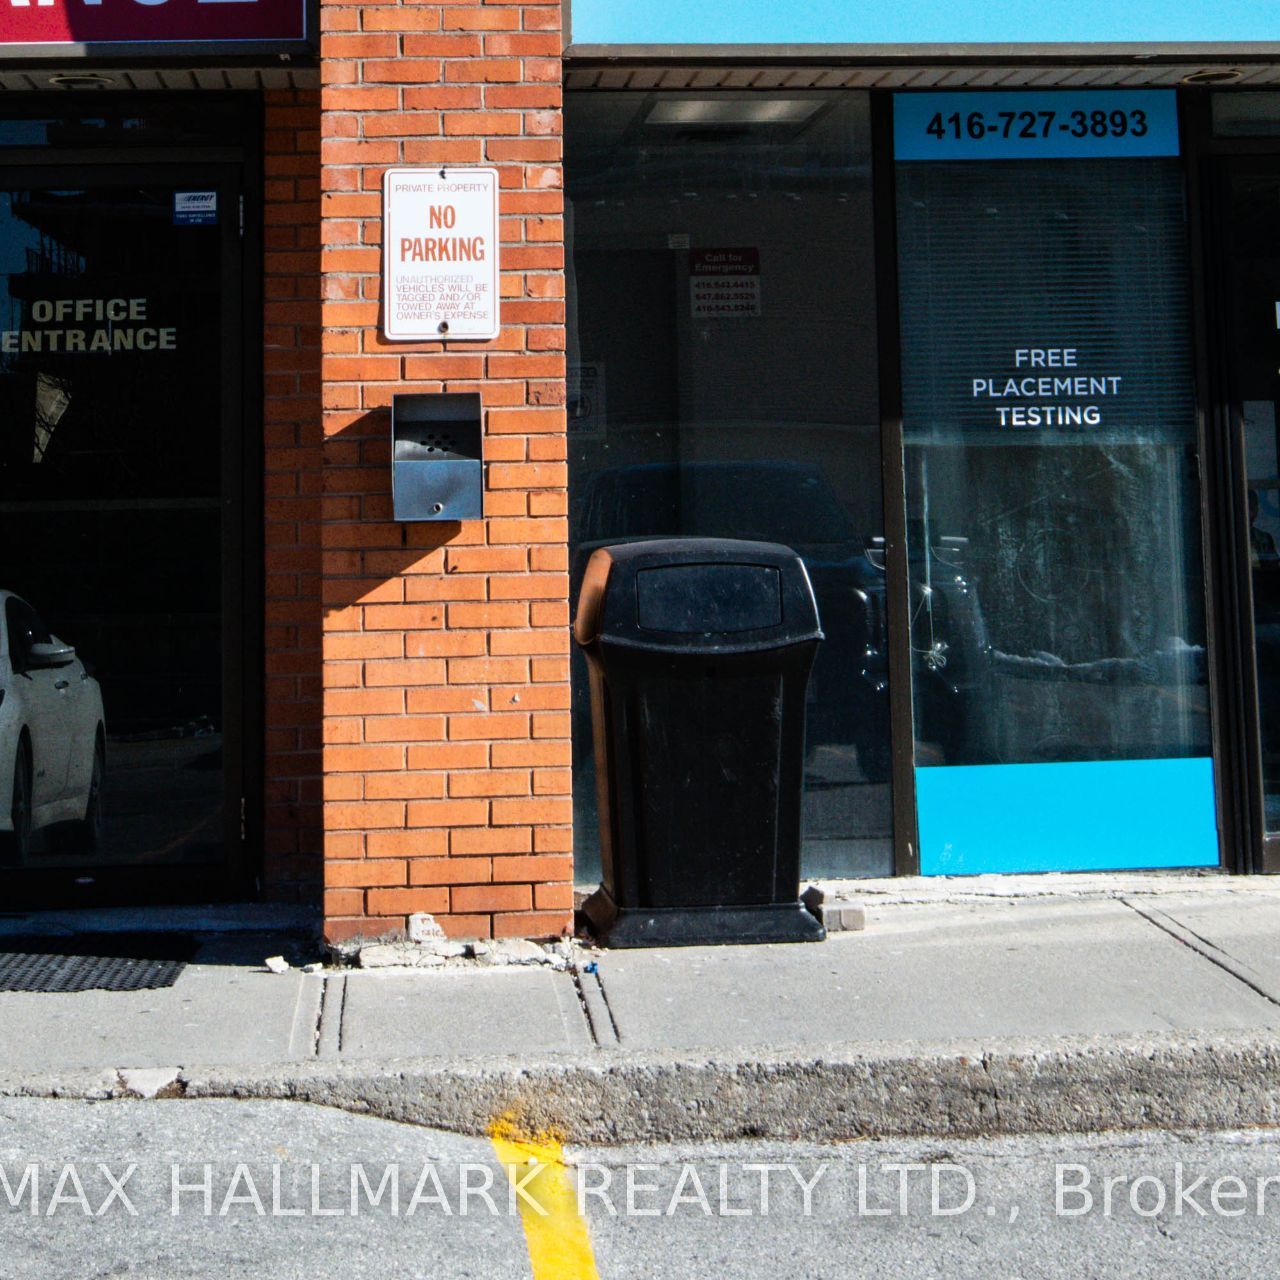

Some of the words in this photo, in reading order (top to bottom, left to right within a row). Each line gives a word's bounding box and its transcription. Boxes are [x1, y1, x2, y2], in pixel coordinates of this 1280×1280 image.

[926, 108, 1149, 140] 416-727-3893
[395, 184, 433, 193] PRIVATE
[437, 183, 489, 193] PROPERTY
[429, 204, 456, 230] NO
[400, 236, 485, 262] PARKING
[396, 275, 474, 284] UNAUTHORIZED
[396, 284, 445, 293] VEHICLES
[448, 284, 470, 292] WILL
[475, 284, 488, 292] BE
[396, 293, 436, 302] TAGGED
[439, 293, 481, 302] AND/OR
[396, 302, 432, 311] TOWED
[436, 302, 460, 311] AWAY
[464, 302, 475, 311] AT
[31, 298, 148, 323] OFFICE
[396, 311, 441, 320] OWNER'S
[444, 311, 489, 320] EXPENSE
[1, 327, 177, 353] ENTRANCE
[1015, 348, 1078, 368] FREE
[972, 376, 1122, 397] PLACEMENT
[995, 405, 1102, 426] TESTING
